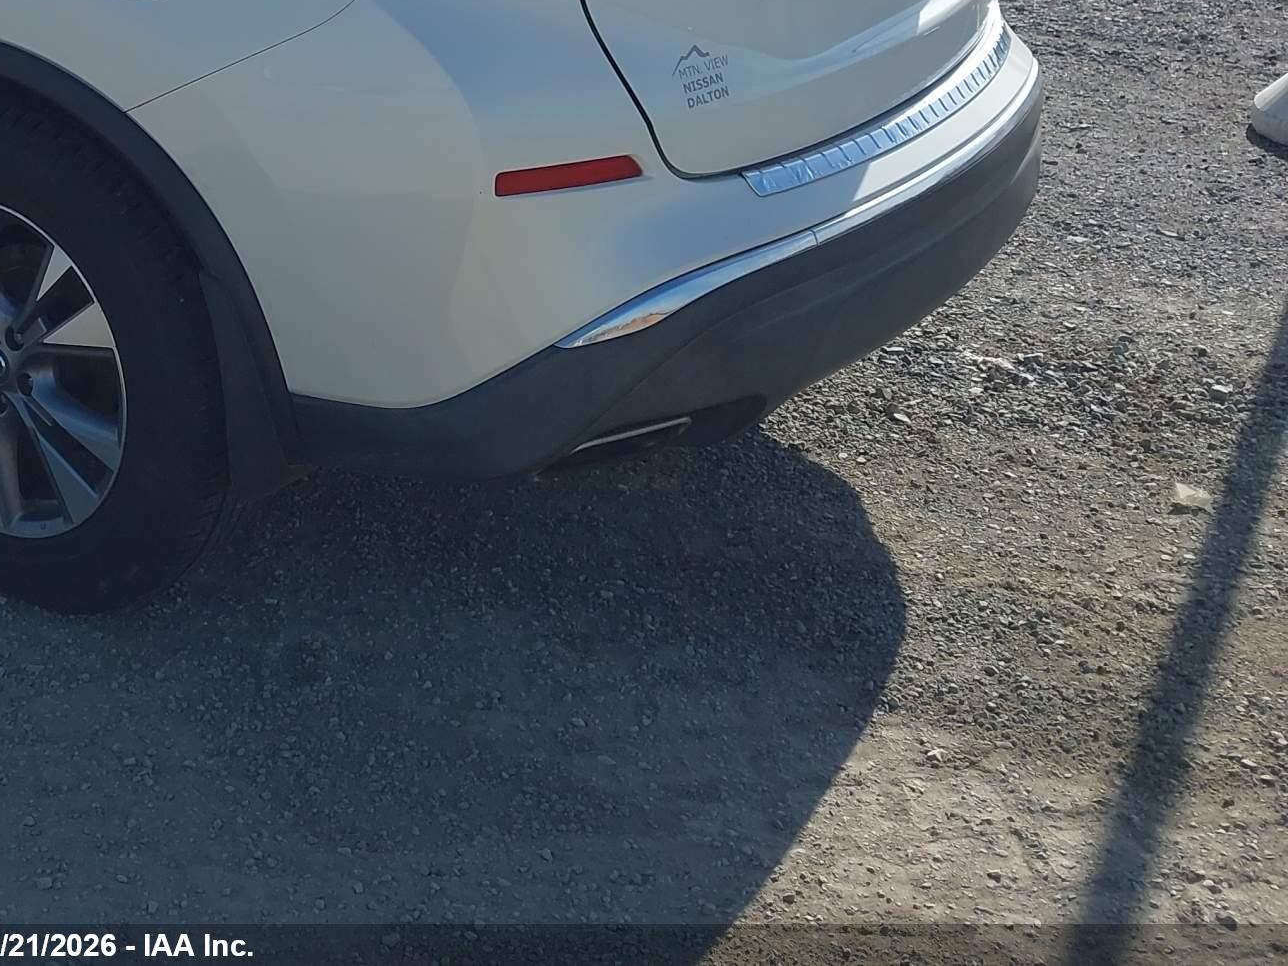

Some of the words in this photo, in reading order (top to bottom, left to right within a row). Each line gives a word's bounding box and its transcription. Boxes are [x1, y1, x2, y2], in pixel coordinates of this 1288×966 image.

[703, 54, 729, 71] VIEW
[682, 73, 724, 94] NISSAN
[687, 85, 730, 109] DALTON
